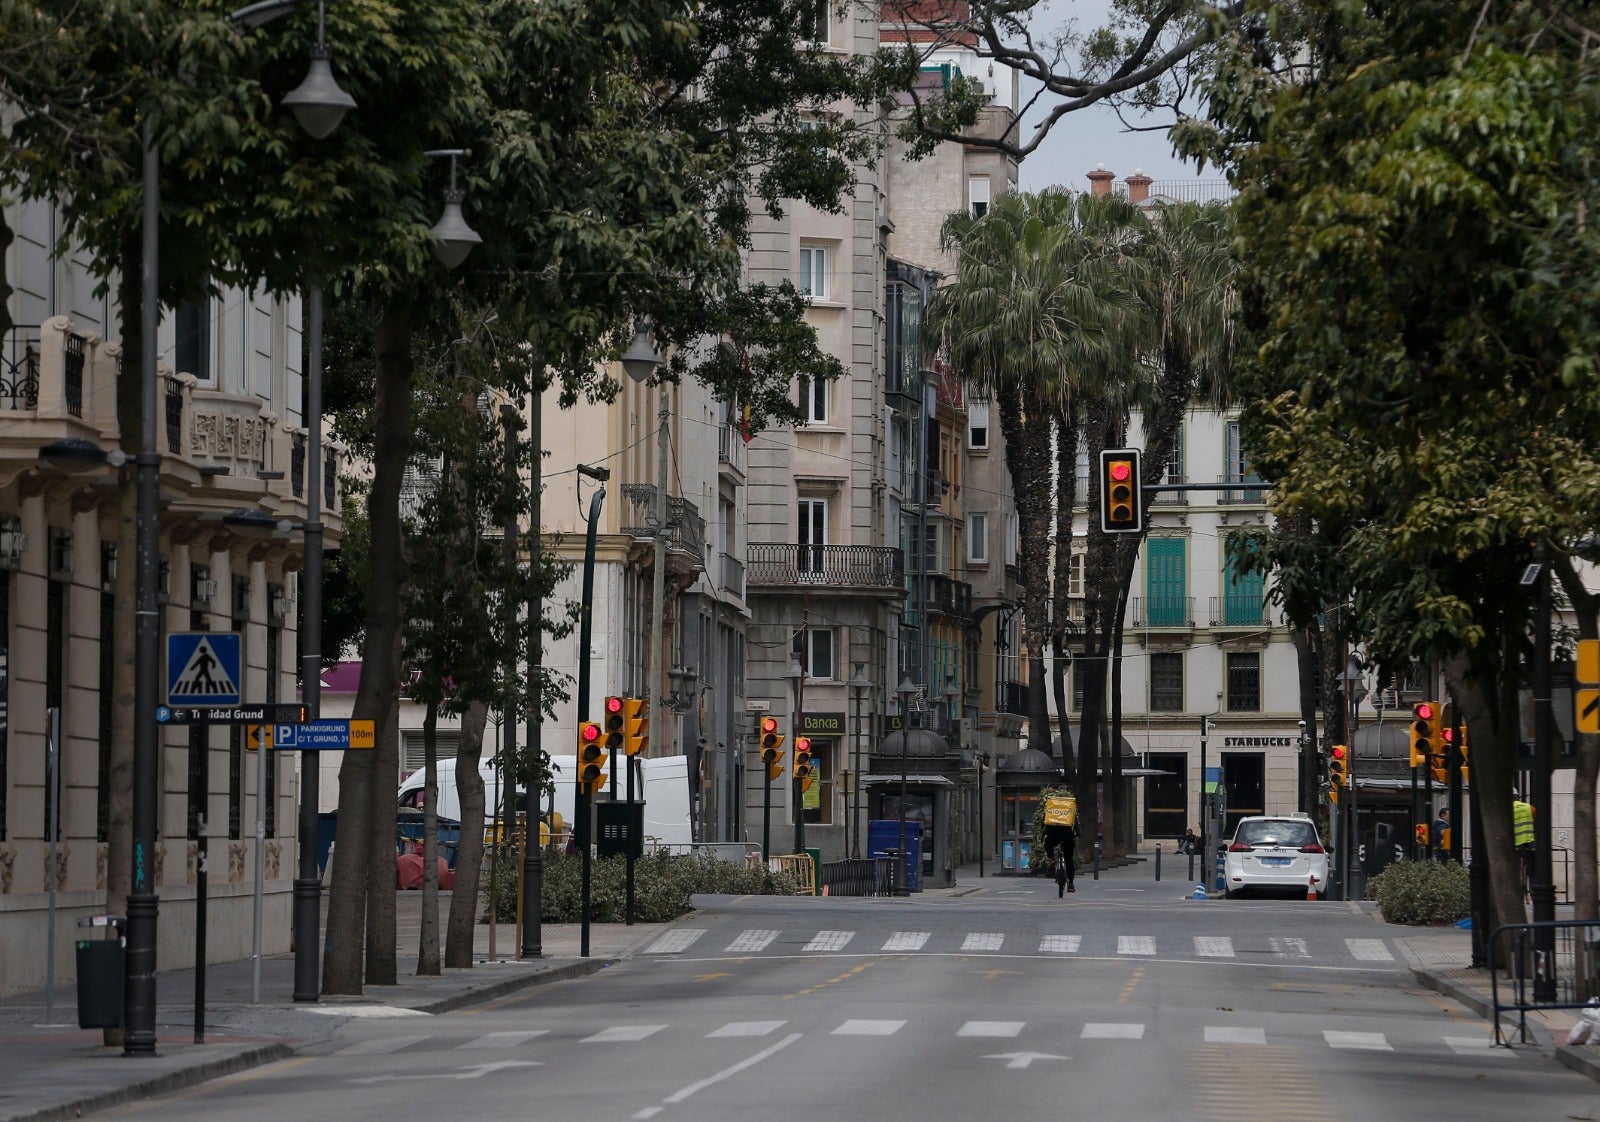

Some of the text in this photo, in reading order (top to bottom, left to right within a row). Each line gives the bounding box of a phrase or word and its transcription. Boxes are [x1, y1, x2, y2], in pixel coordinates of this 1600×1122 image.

[160, 709, 167, 718] P
[233, 709, 264, 719] Grund
[804, 717, 838, 729] Bankia
[279, 726, 291, 743] P
[313, 735, 340, 743] GRUND,
[351, 730, 373, 739] 100m
[1224, 737, 1291, 747] STARBUCKS
